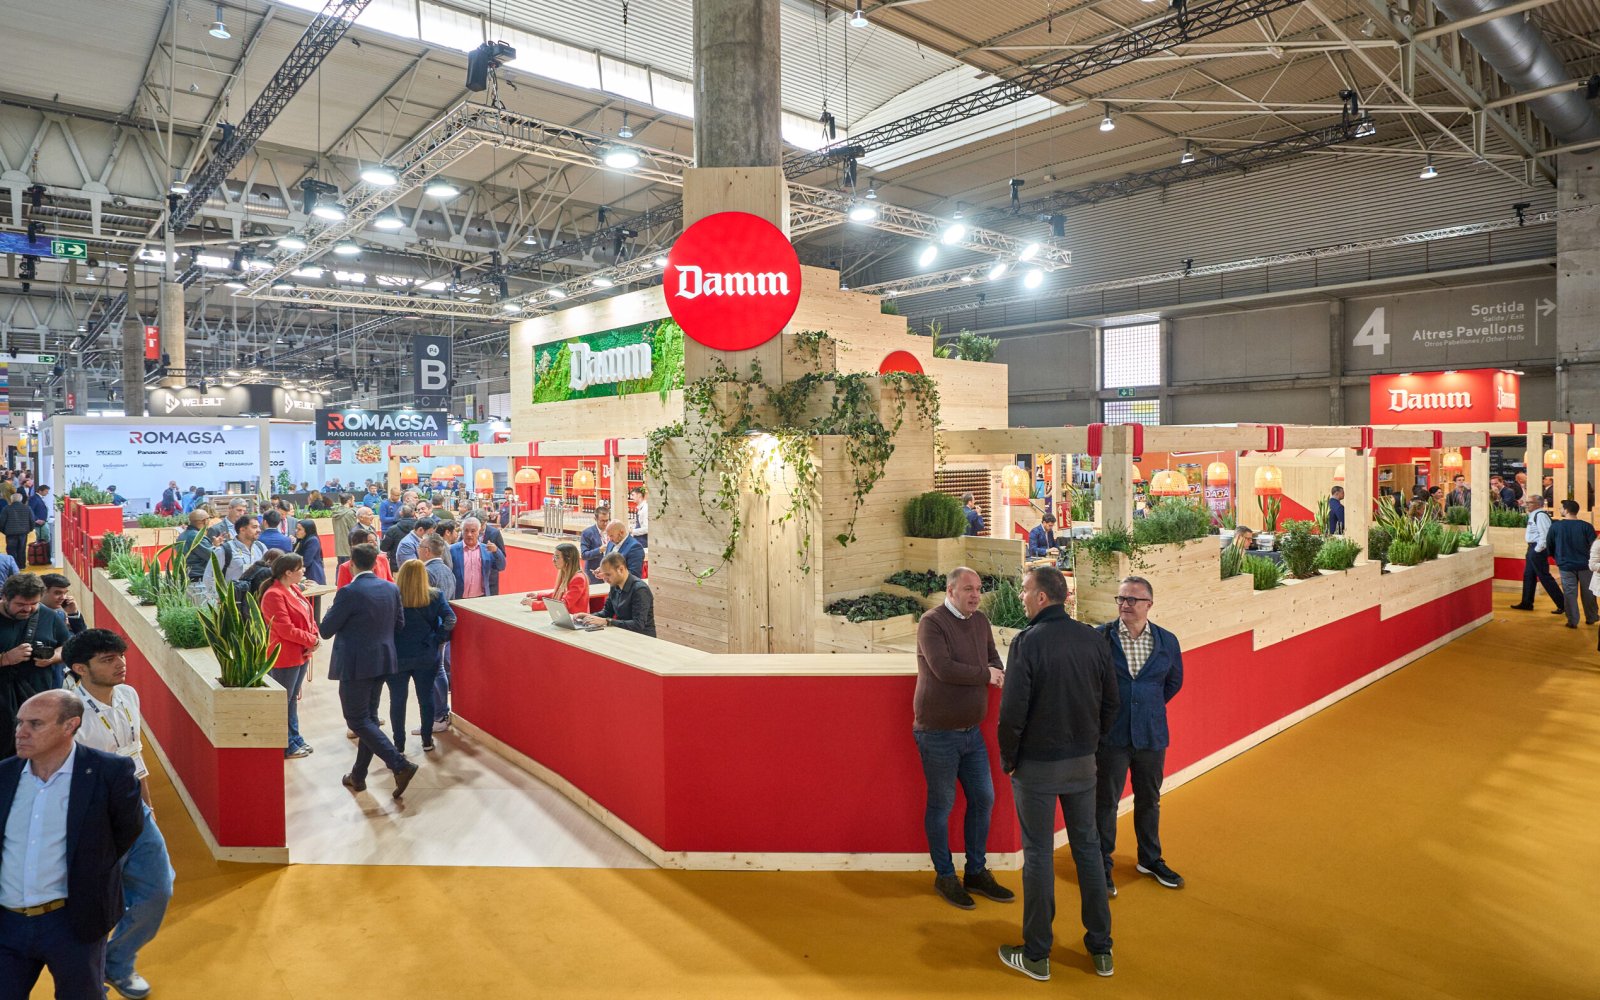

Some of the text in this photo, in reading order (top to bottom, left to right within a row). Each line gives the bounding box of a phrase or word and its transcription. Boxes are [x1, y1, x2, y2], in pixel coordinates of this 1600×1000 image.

[674, 264, 791, 300] Damm
[1471, 301, 1525, 317] Sortida
[1483, 314, 1505, 323] Salida
[1511, 313, 1525, 321] Exit
[1352, 306, 1391, 356] 4
[1412, 323, 1525, 341] Altres Pavellons
[421, 359, 447, 390] B
[567, 342, 653, 391] Damm
[181, 397, 225, 407] WELBILT
[421, 396, 430, 407] C
[440, 397, 448, 407] A
[1388, 388, 1472, 412] Damm
[327, 413, 438, 431] ROMAGSA
[129, 431, 226, 444] ROMAGSA
